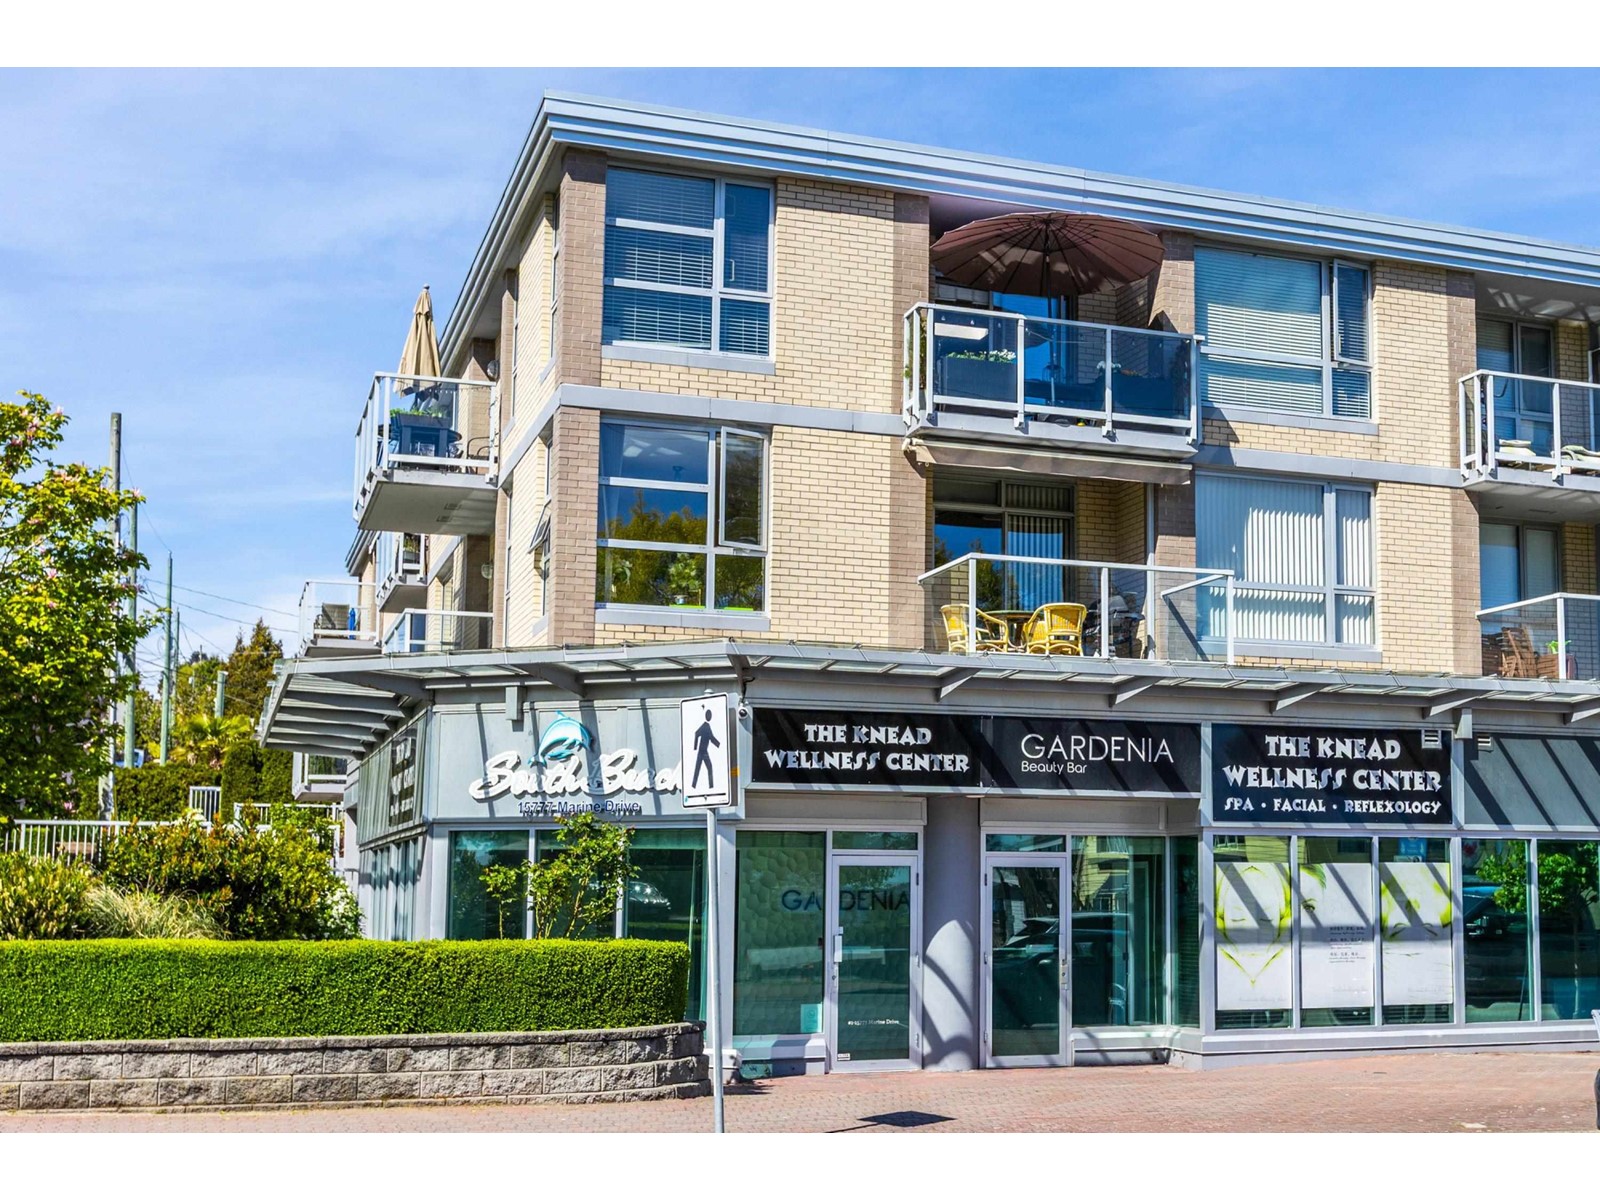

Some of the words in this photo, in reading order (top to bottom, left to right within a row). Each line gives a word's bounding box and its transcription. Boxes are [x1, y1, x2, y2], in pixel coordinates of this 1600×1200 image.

[803, 723, 847, 743] THE
[852, 725, 933, 746] KNEAD
[1020, 732, 1175, 764] GARDENIA
[1265, 735, 1311, 758] THE
[1316, 737, 1401, 761] KNEAD
[763, 749, 880, 771] WELLNESS
[885, 753, 970, 773] CENTER
[1021, 760, 1064, 774] Beauty
[1067, 762, 1088, 774] Bar
[1222, 765, 1347, 790] WELLNESS
[1352, 769, 1442, 793] CENTER
[558, 801, 601, 813] Marine
[605, 801, 639, 812] Drive
[1224, 797, 1254, 811] SPA
[1273, 798, 1326, 813] FACIAL
[1344, 800, 1442, 815] REFLEXOLOGY
[781, 889, 911, 912] GADENIA
